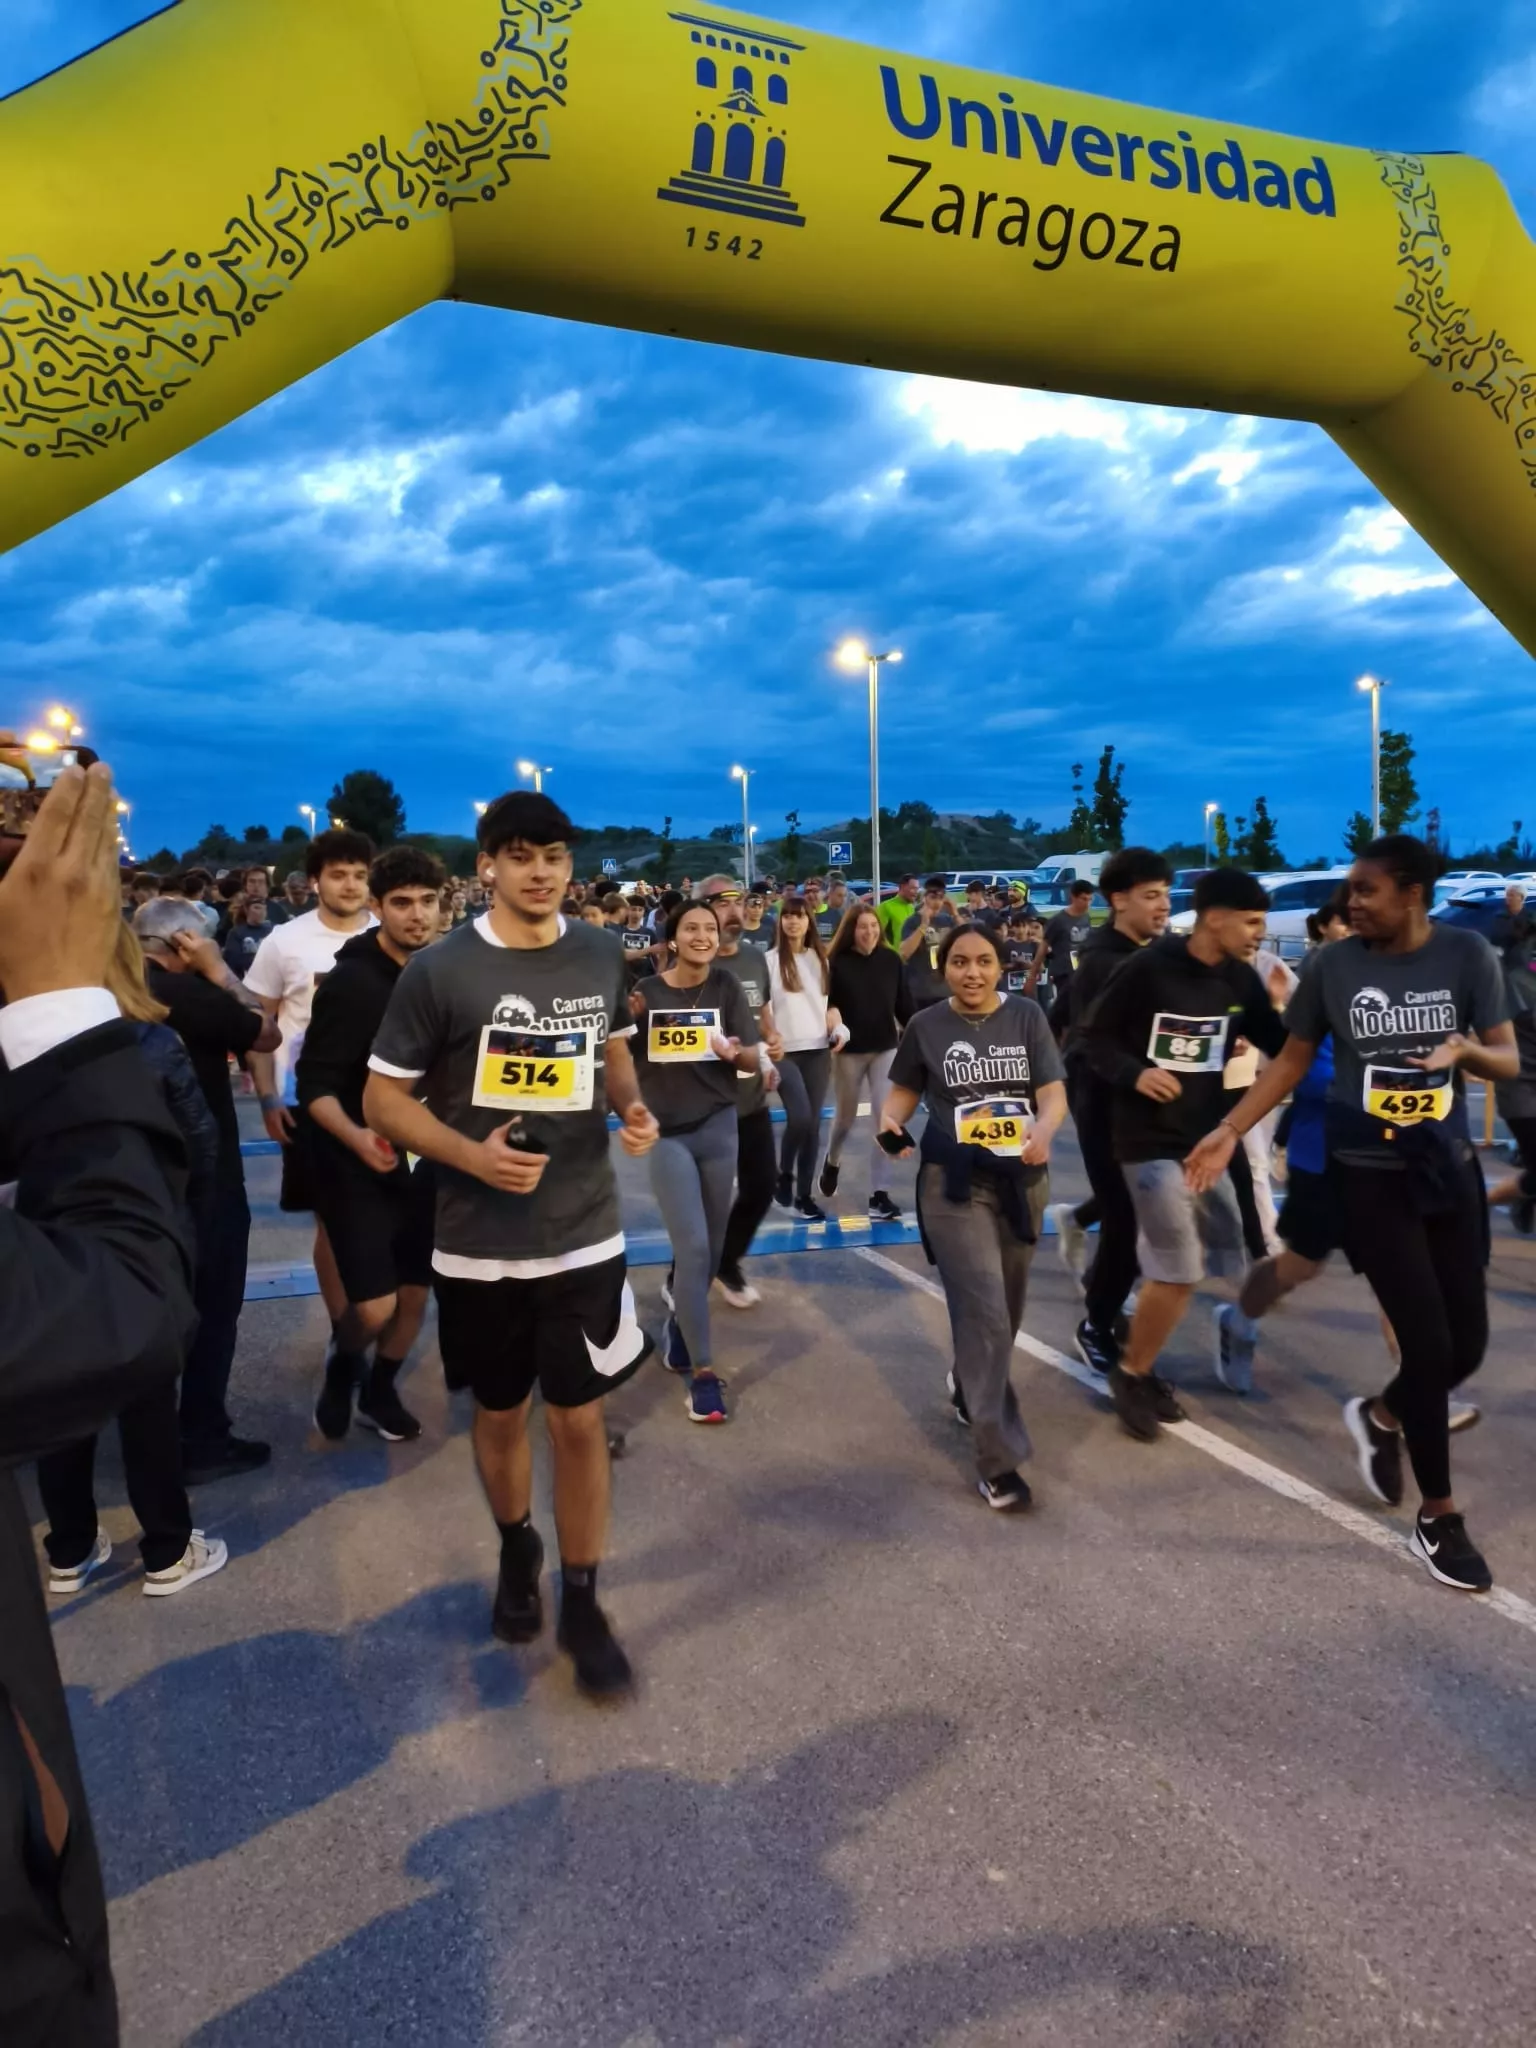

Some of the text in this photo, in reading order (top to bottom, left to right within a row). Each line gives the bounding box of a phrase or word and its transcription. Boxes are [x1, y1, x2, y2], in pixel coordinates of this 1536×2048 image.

[879, 65, 1337, 217] Universidad
[880, 154, 1183, 272] Zaragoza
[686, 226, 763, 260] 1542
[831, 844, 842, 858] P
[552, 994, 605, 1015] Carrera
[1404, 989, 1453, 1004] Carrera
[1350, 1003, 1457, 1040] Nocturna
[658, 1030, 698, 1047] 505
[1169, 1037, 1201, 1057] 86
[988, 1045, 1027, 1057] Carrera
[500, 1061, 560, 1088] 514
[943, 1057, 1031, 1087] Nocturna
[1380, 1094, 1435, 1115] 492
[970, 1120, 1017, 1140] 438
